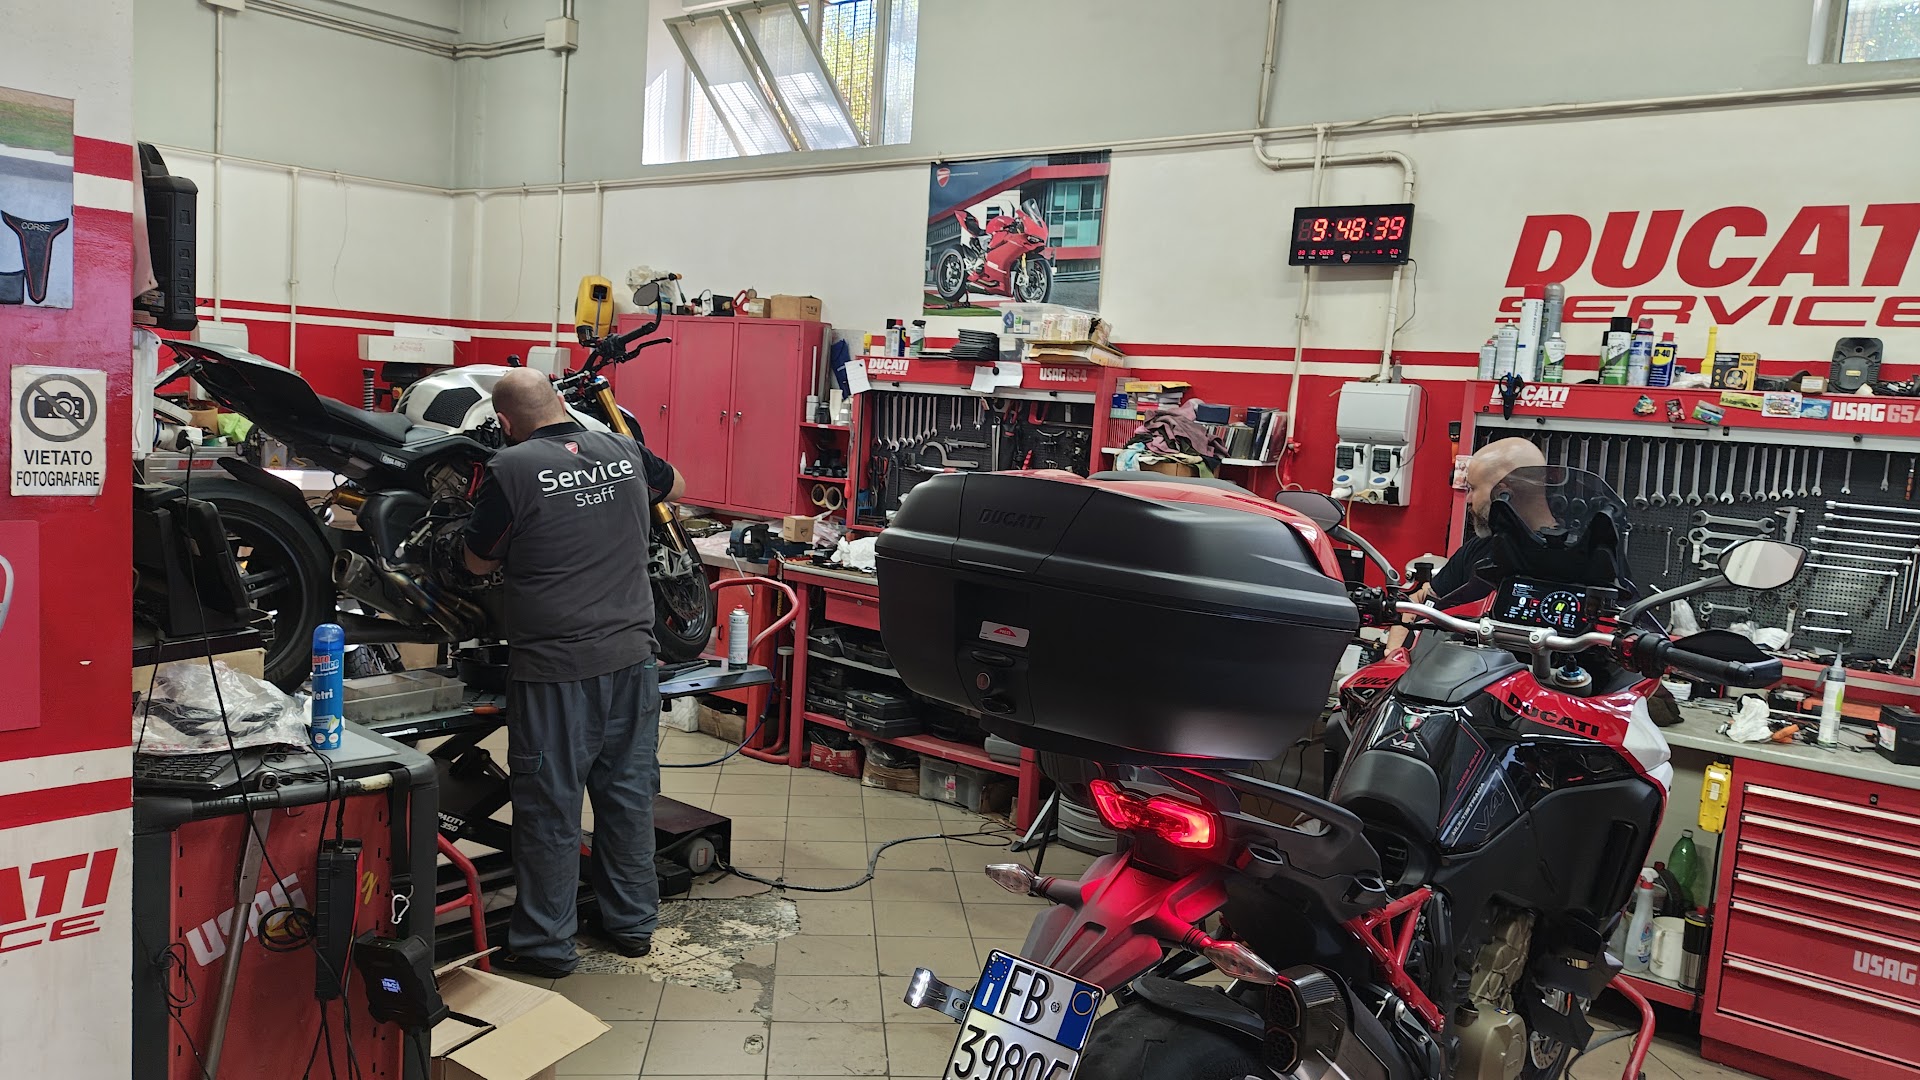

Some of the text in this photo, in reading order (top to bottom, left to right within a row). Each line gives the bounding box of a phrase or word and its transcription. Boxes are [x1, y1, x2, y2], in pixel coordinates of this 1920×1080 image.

[21, 221, 51, 232] CORSE
[1312, 216, 1406, 241] 9:48:39
[868, 358, 910, 371] DUCATI
[1039, 367, 1088, 382] USAG 654
[1832, 402, 1886, 422] USAG
[24, 450, 93, 465] VIETATO
[16, 471, 100, 487] FOTOGRAFARE
[538, 459, 634, 492] Service
[575, 485, 616, 507] Staff
[979, 509, 1048, 530] DUCATI
[1507, 692, 1600, 737] DUCATI
[1451, 782, 1485, 837] MULTISTRADA
[1474, 788, 1505, 831] V4
[440, 821, 459, 832] 350
[1852, 950, 1918, 986] USAG
[999, 964, 1052, 1025] FB
